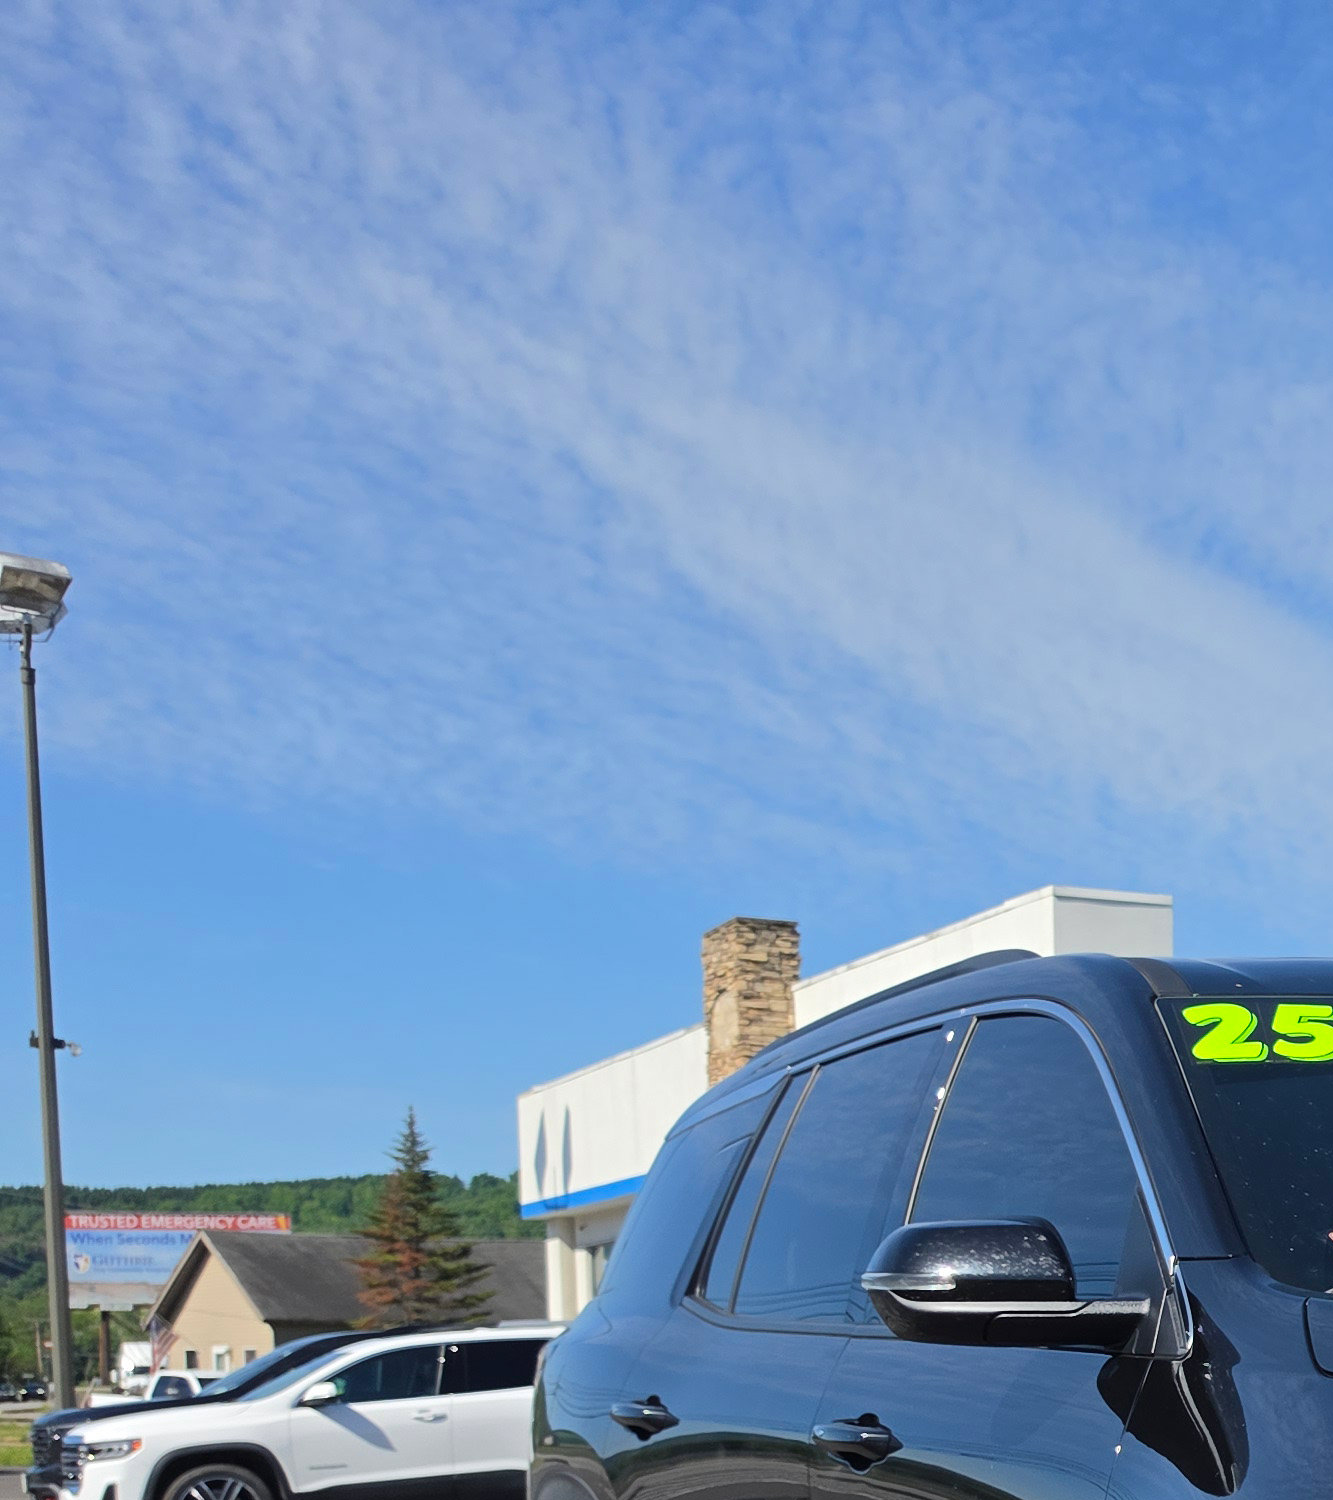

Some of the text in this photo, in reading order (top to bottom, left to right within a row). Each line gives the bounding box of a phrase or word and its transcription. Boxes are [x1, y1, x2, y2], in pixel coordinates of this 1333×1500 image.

[70, 1215, 276, 1229] TRUSTED EMERGENCY CARE
[70, 1233, 114, 1245] When
[117, 1233, 176, 1244] Seconds
